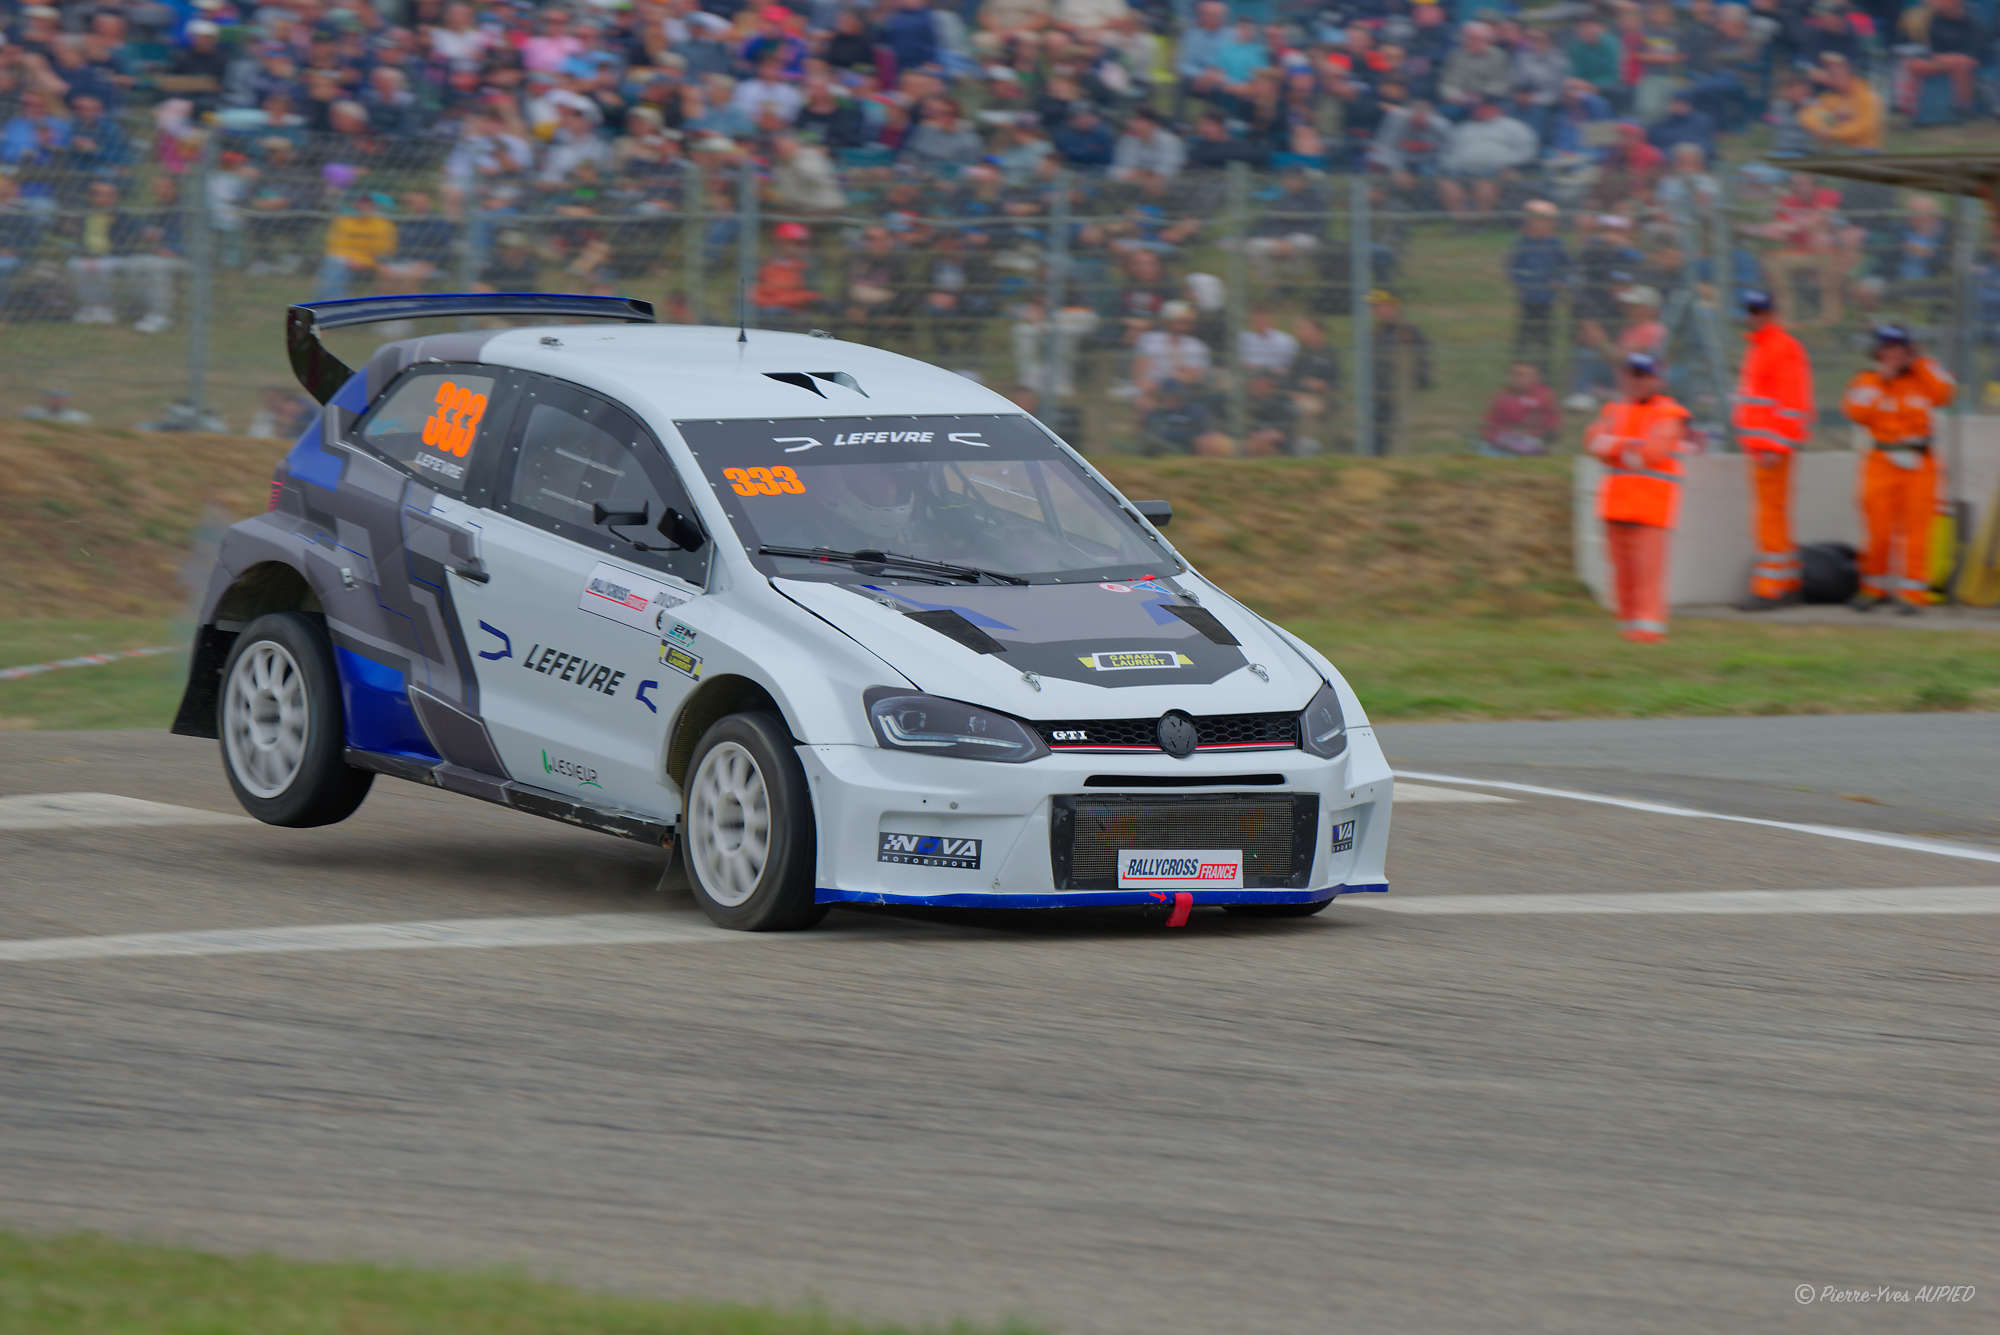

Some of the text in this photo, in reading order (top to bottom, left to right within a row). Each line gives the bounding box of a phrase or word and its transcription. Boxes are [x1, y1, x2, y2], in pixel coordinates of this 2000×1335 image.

[422, 381, 488, 458] 333
[833, 431, 935, 446] LEFEVRE
[414, 451, 465, 479] LEFEVRE
[722, 465, 806, 497] 333
[523, 644, 626, 696] LEFEVRE
[1112, 659, 1166, 667] LAURENT
[1052, 730, 1088, 741] GTI
[552, 757, 598, 782] LESIEUR
[891, 834, 977, 857] NOVA
[882, 855, 977, 868] MOTORSPORT
[1128, 858, 1236, 879] RALLYCROSS FRANCE
